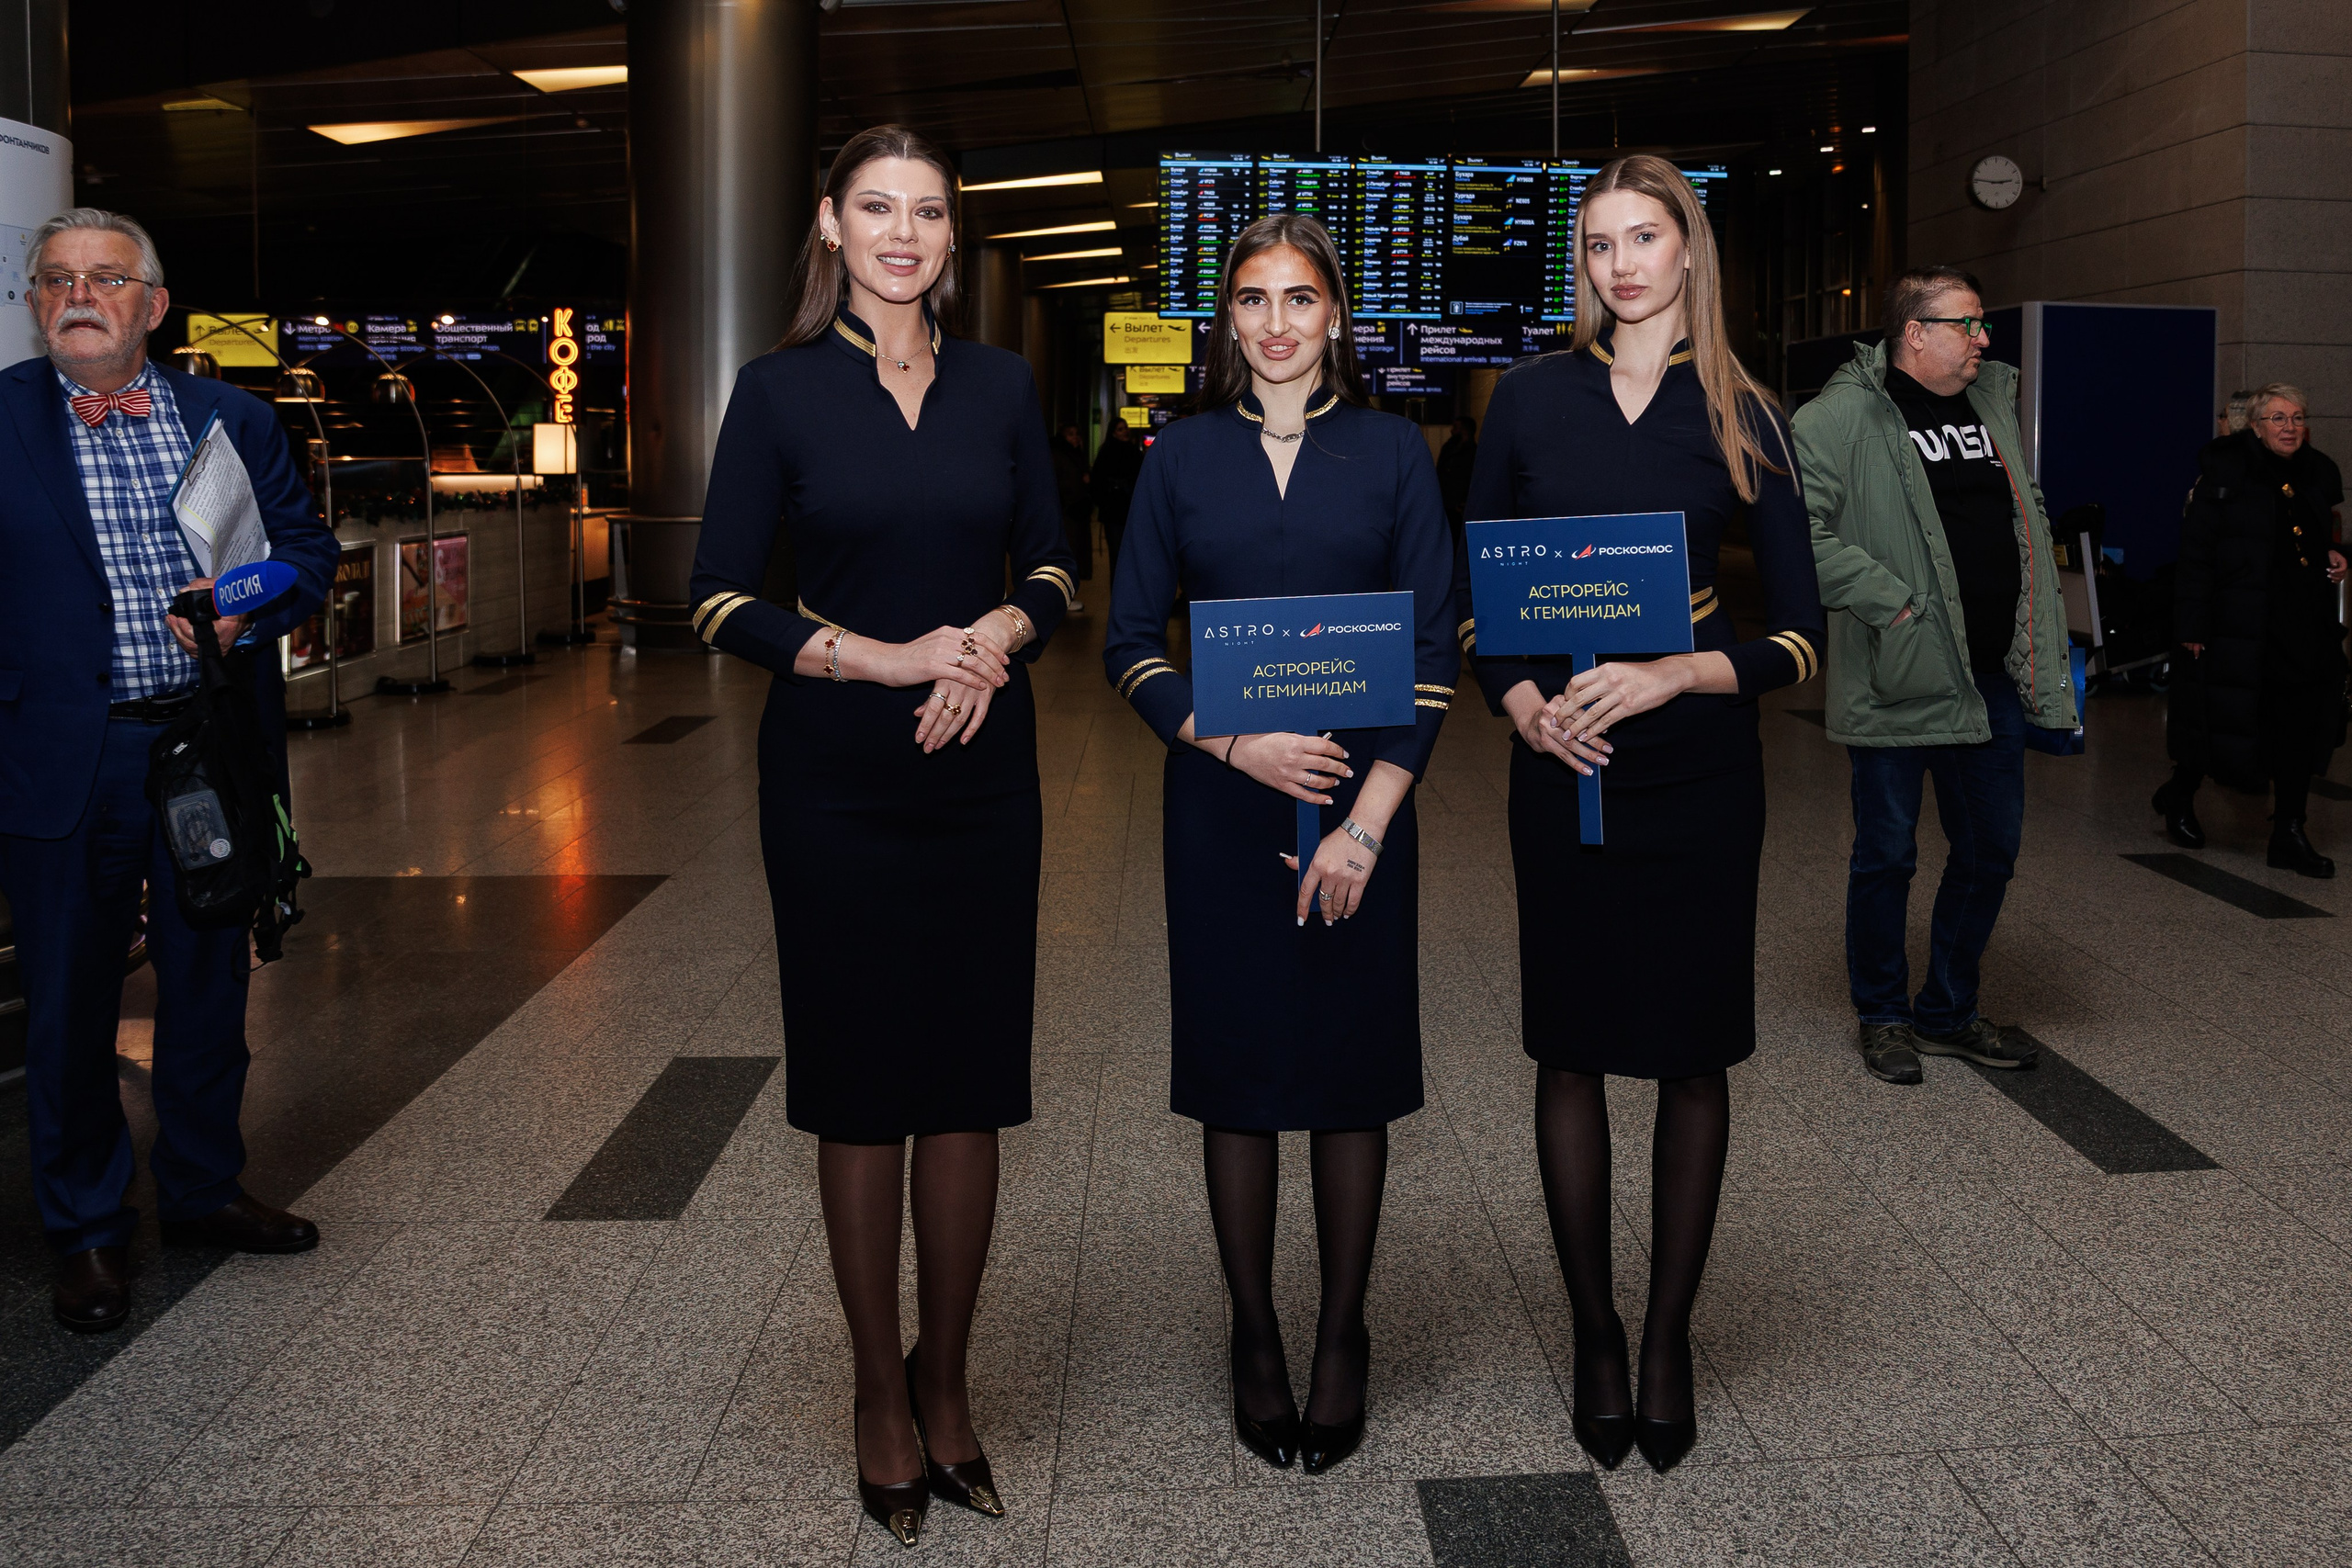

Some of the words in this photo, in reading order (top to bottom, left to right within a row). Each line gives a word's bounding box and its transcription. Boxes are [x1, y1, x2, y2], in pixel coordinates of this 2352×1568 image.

[298, 325, 331, 334] Метро
[368, 325, 406, 333] Камера
[437, 324, 513, 333] Общественный
[1125, 323, 1163, 333] Вылет
[1420, 327, 1456, 335] Прилет
[1522, 326, 1555, 335] Туалет
[435, 335, 488, 344] транспорт
[1420, 336, 1503, 345] международных
[1420, 346, 1455, 355] рейсов
[549, 308, 579, 423] КОФЕ
[1481, 544, 1546, 558] ASTRO
[1599, 544, 1673, 556] РОСКОСМОС
[219, 573, 263, 606] РОССИЯ
[1529, 580, 1629, 599] АСТРОРЕЙС
[1521, 607, 1530, 620] К
[1534, 604, 1641, 620] ГЕМИНИДАМ
[1204, 624, 1274, 639] ASTRO
[1328, 622, 1402, 635] РОСКОСМОС
[1253, 658, 1356, 678] АСТРОРЕЙС
[1243, 686, 1253, 700] К
[1259, 680, 1366, 698] ГЕМИНИДАМ
